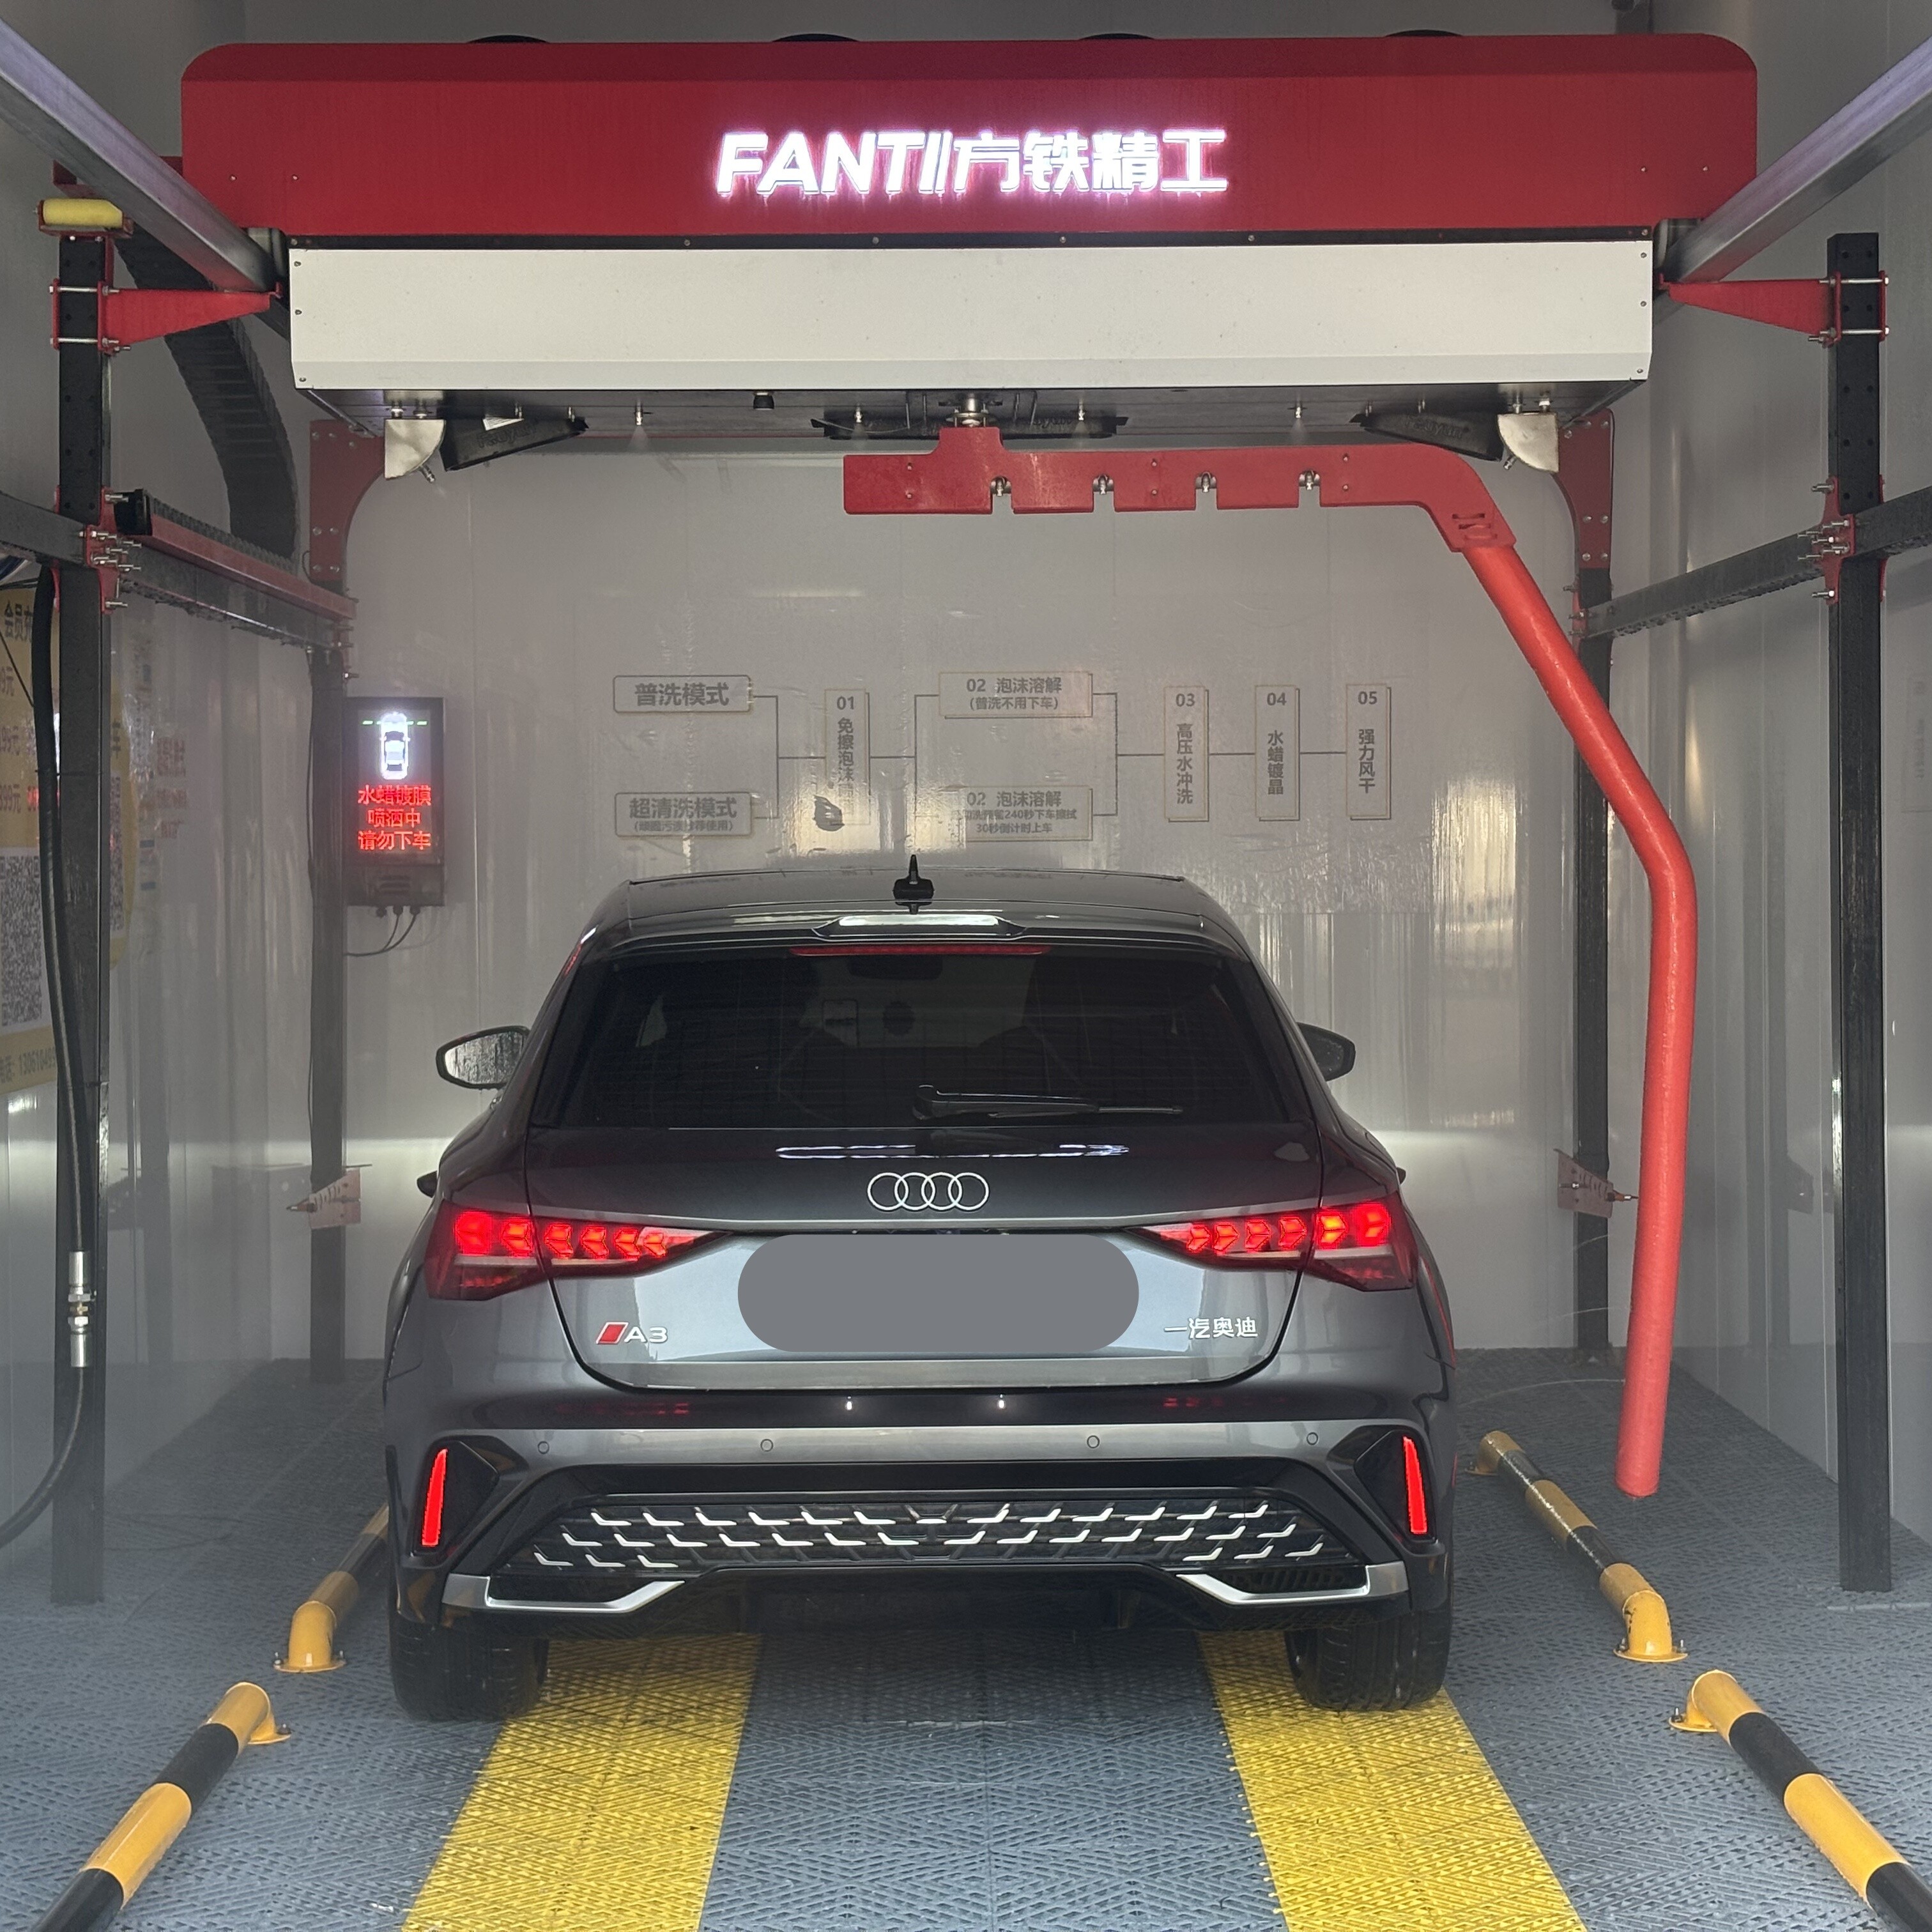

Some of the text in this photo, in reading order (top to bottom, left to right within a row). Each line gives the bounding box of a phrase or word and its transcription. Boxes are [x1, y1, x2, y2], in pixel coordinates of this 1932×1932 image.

[954, 129, 1228, 193] 方铁精工
[634, 682, 730, 707] 普洗模式
[966, 677, 1062, 694] 02 泡沫溶解
[836, 696, 855, 710] 01
[970, 696, 1059, 711] (普洗不用下车)
[1175, 693, 1196, 707] 03
[1267, 692, 1287, 706] 04
[1358, 691, 1378, 705] 05
[1176, 723, 1194, 805] 高压水冲洗
[1267, 730, 1284, 795] 水蜡镀晶
[1358, 728, 1376, 794] 强力风干
[357, 785, 432, 806] 水蜡镀膜
[966, 790, 1062, 808] 02 泡沫溶解
[367, 808, 421, 828] 喷洒中
[629, 797, 738, 819] 超清洗模式
[357, 830, 432, 850] 请勿下车
[624, 1326, 668, 1344] A3
[1163, 1316, 1259, 1339] 一汽奥迪
